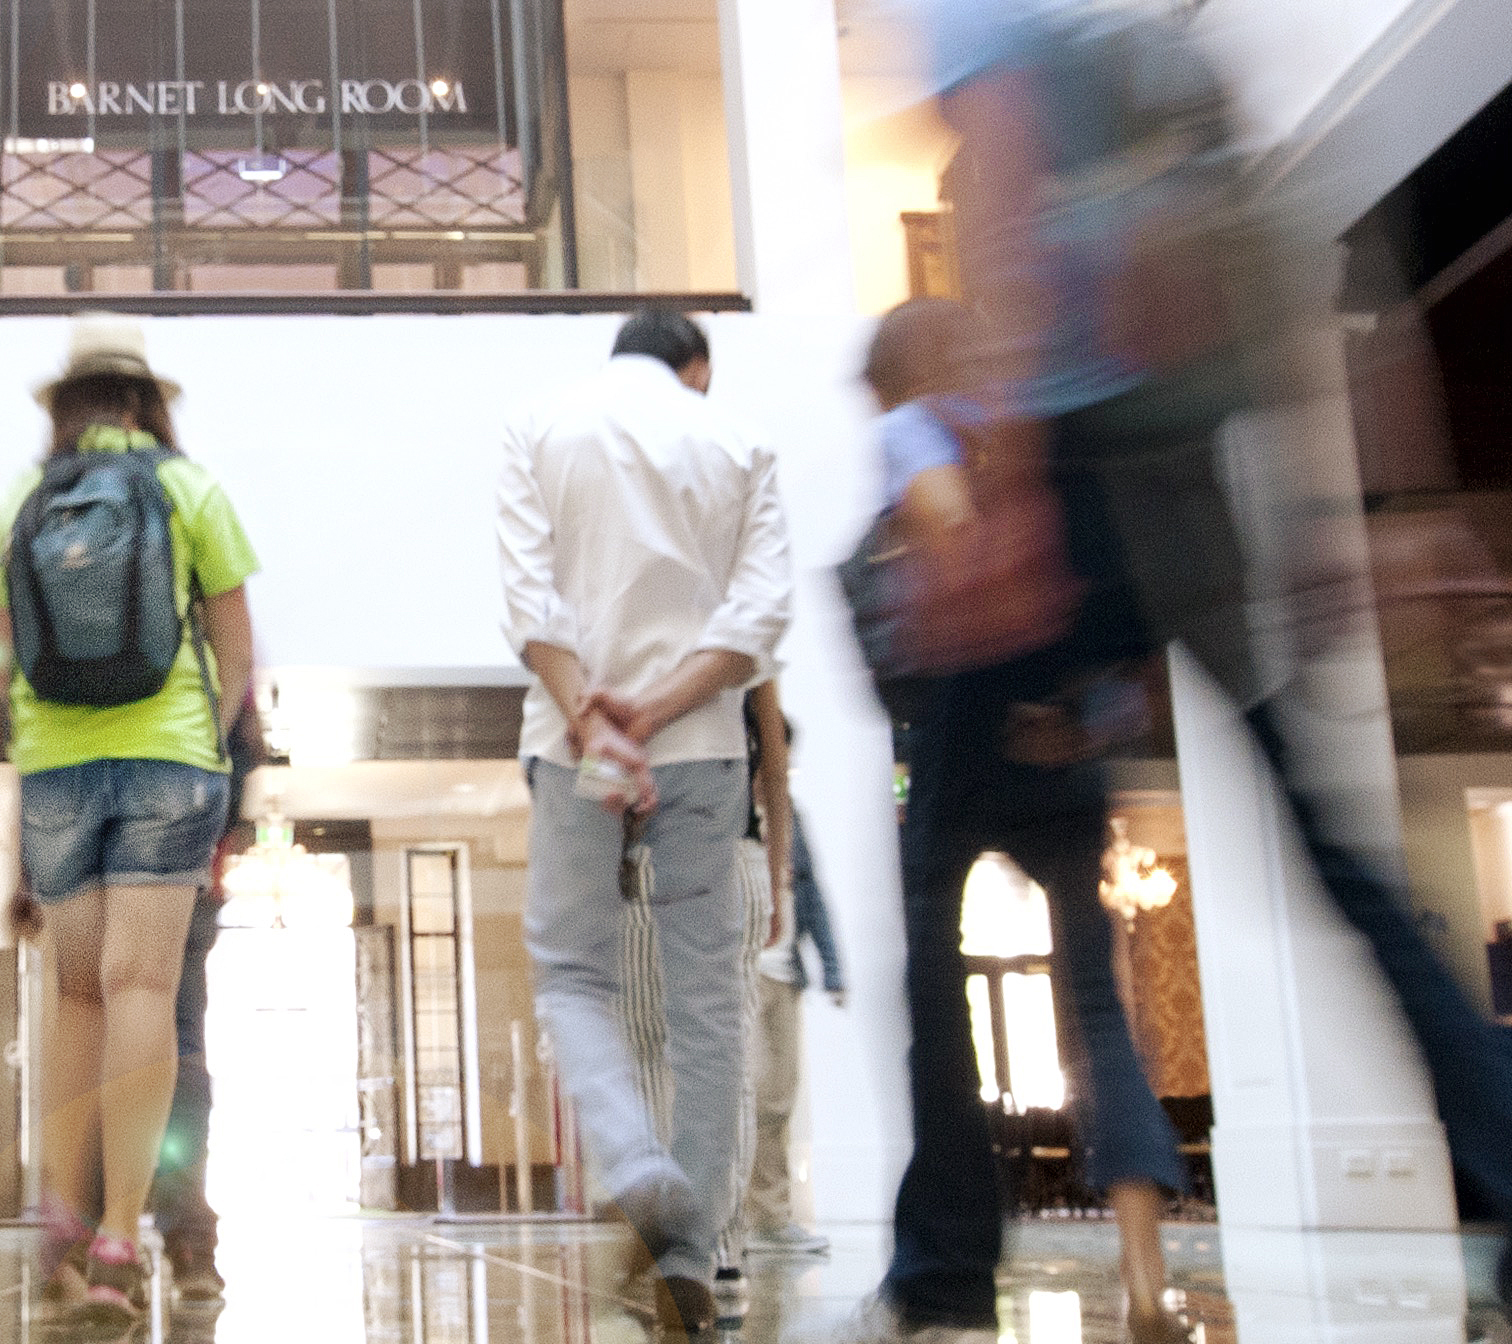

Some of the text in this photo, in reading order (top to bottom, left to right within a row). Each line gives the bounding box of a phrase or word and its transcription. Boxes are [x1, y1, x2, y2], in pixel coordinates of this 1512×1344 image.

[47, 78, 467, 115] BARNET LONG ROOM
